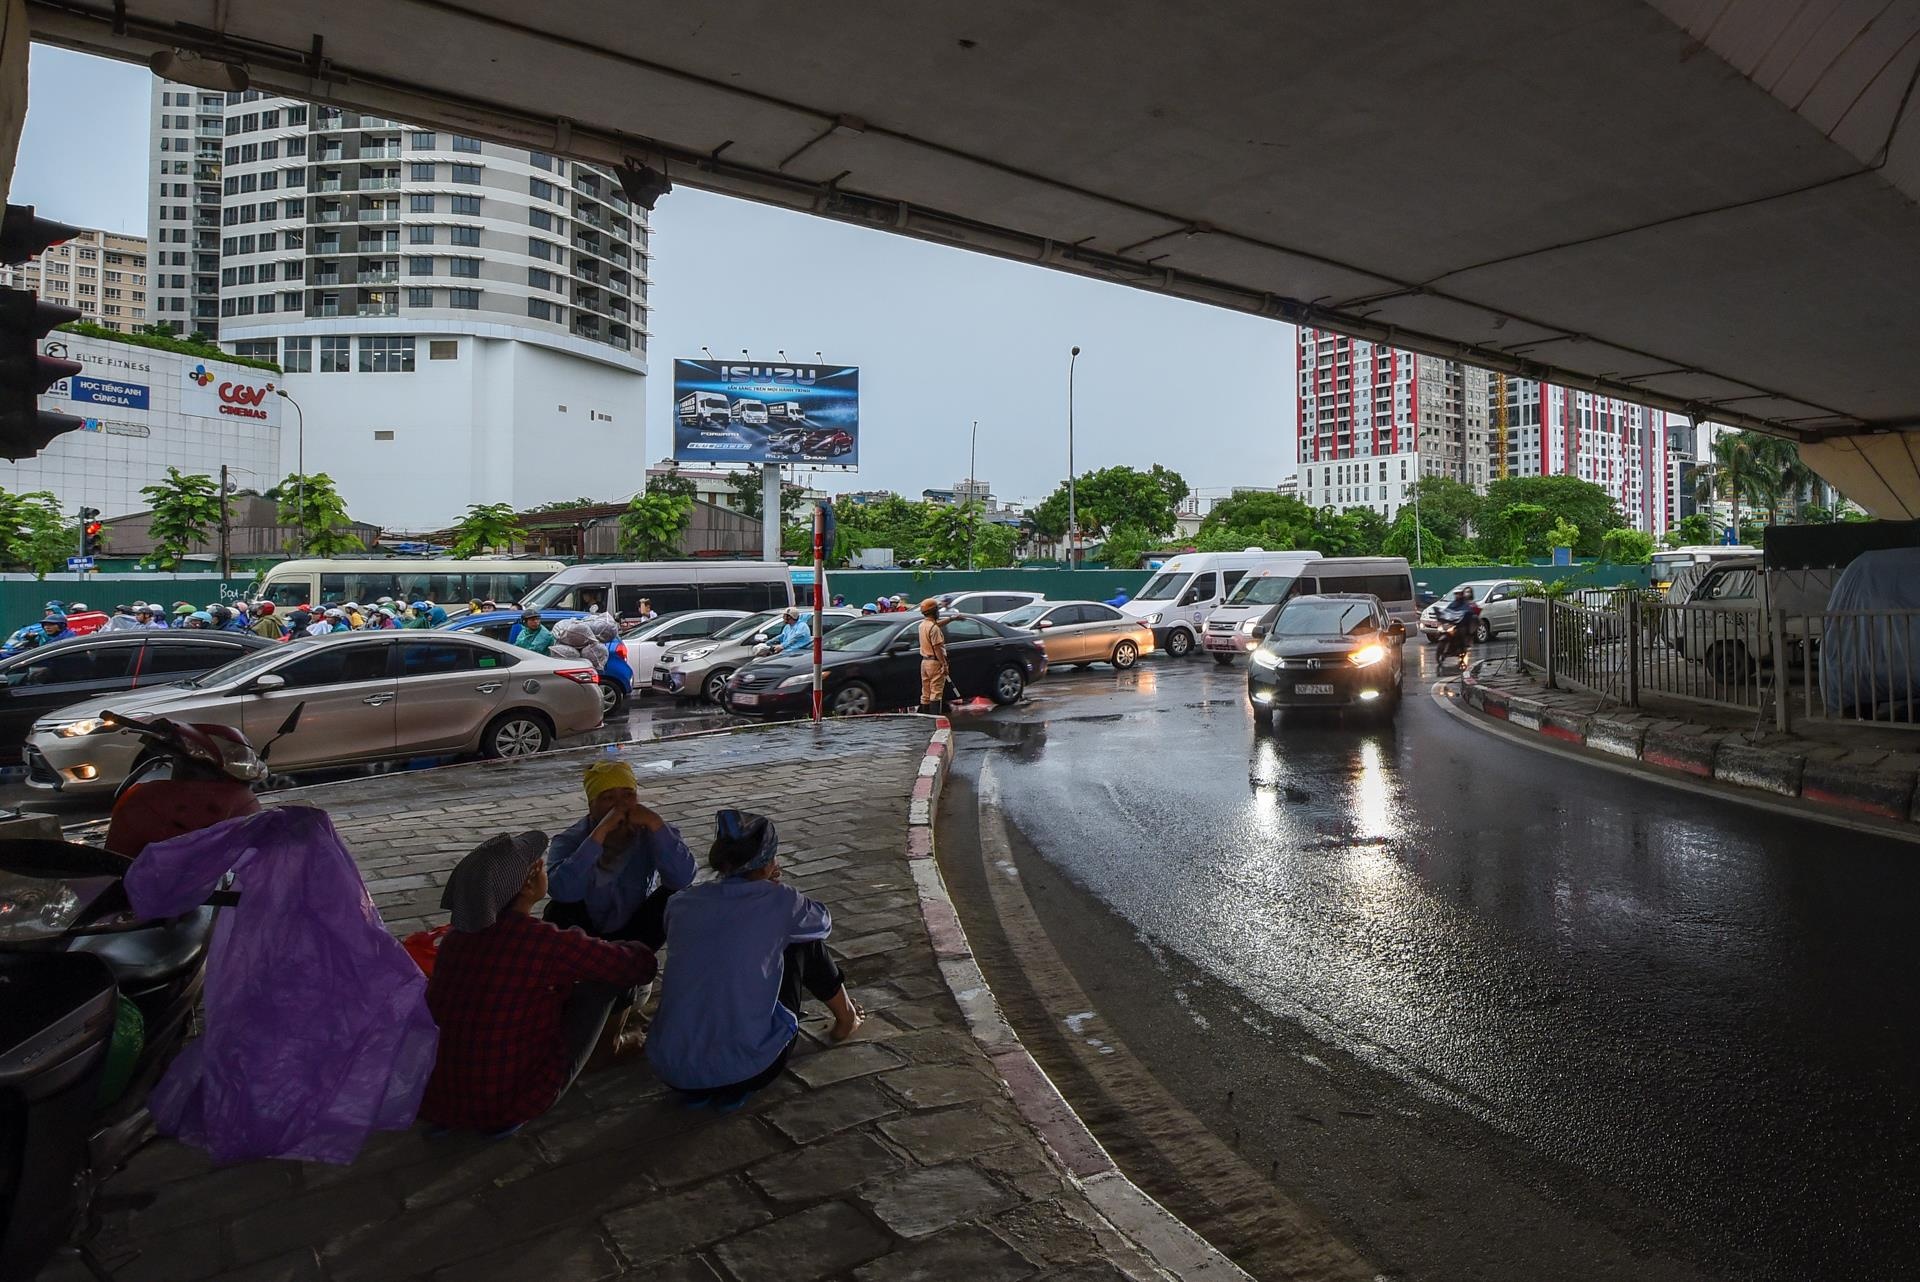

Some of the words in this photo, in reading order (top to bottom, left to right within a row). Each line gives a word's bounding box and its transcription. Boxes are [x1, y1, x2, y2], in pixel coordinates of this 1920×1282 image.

[76, 353, 103, 364] ELITE
[107, 358, 151, 373] FITNESS
[721, 366, 816, 385] ISUZU
[80, 381, 100, 391] HỌC
[101, 383, 124, 394] TIẾNG
[124, 388, 142, 397] ANH
[218, 382, 266, 406] CGV
[92, 393, 117, 403] CÙNG
[117, 397, 130, 405] ILA
[219, 405, 267, 419] CINEMAS
